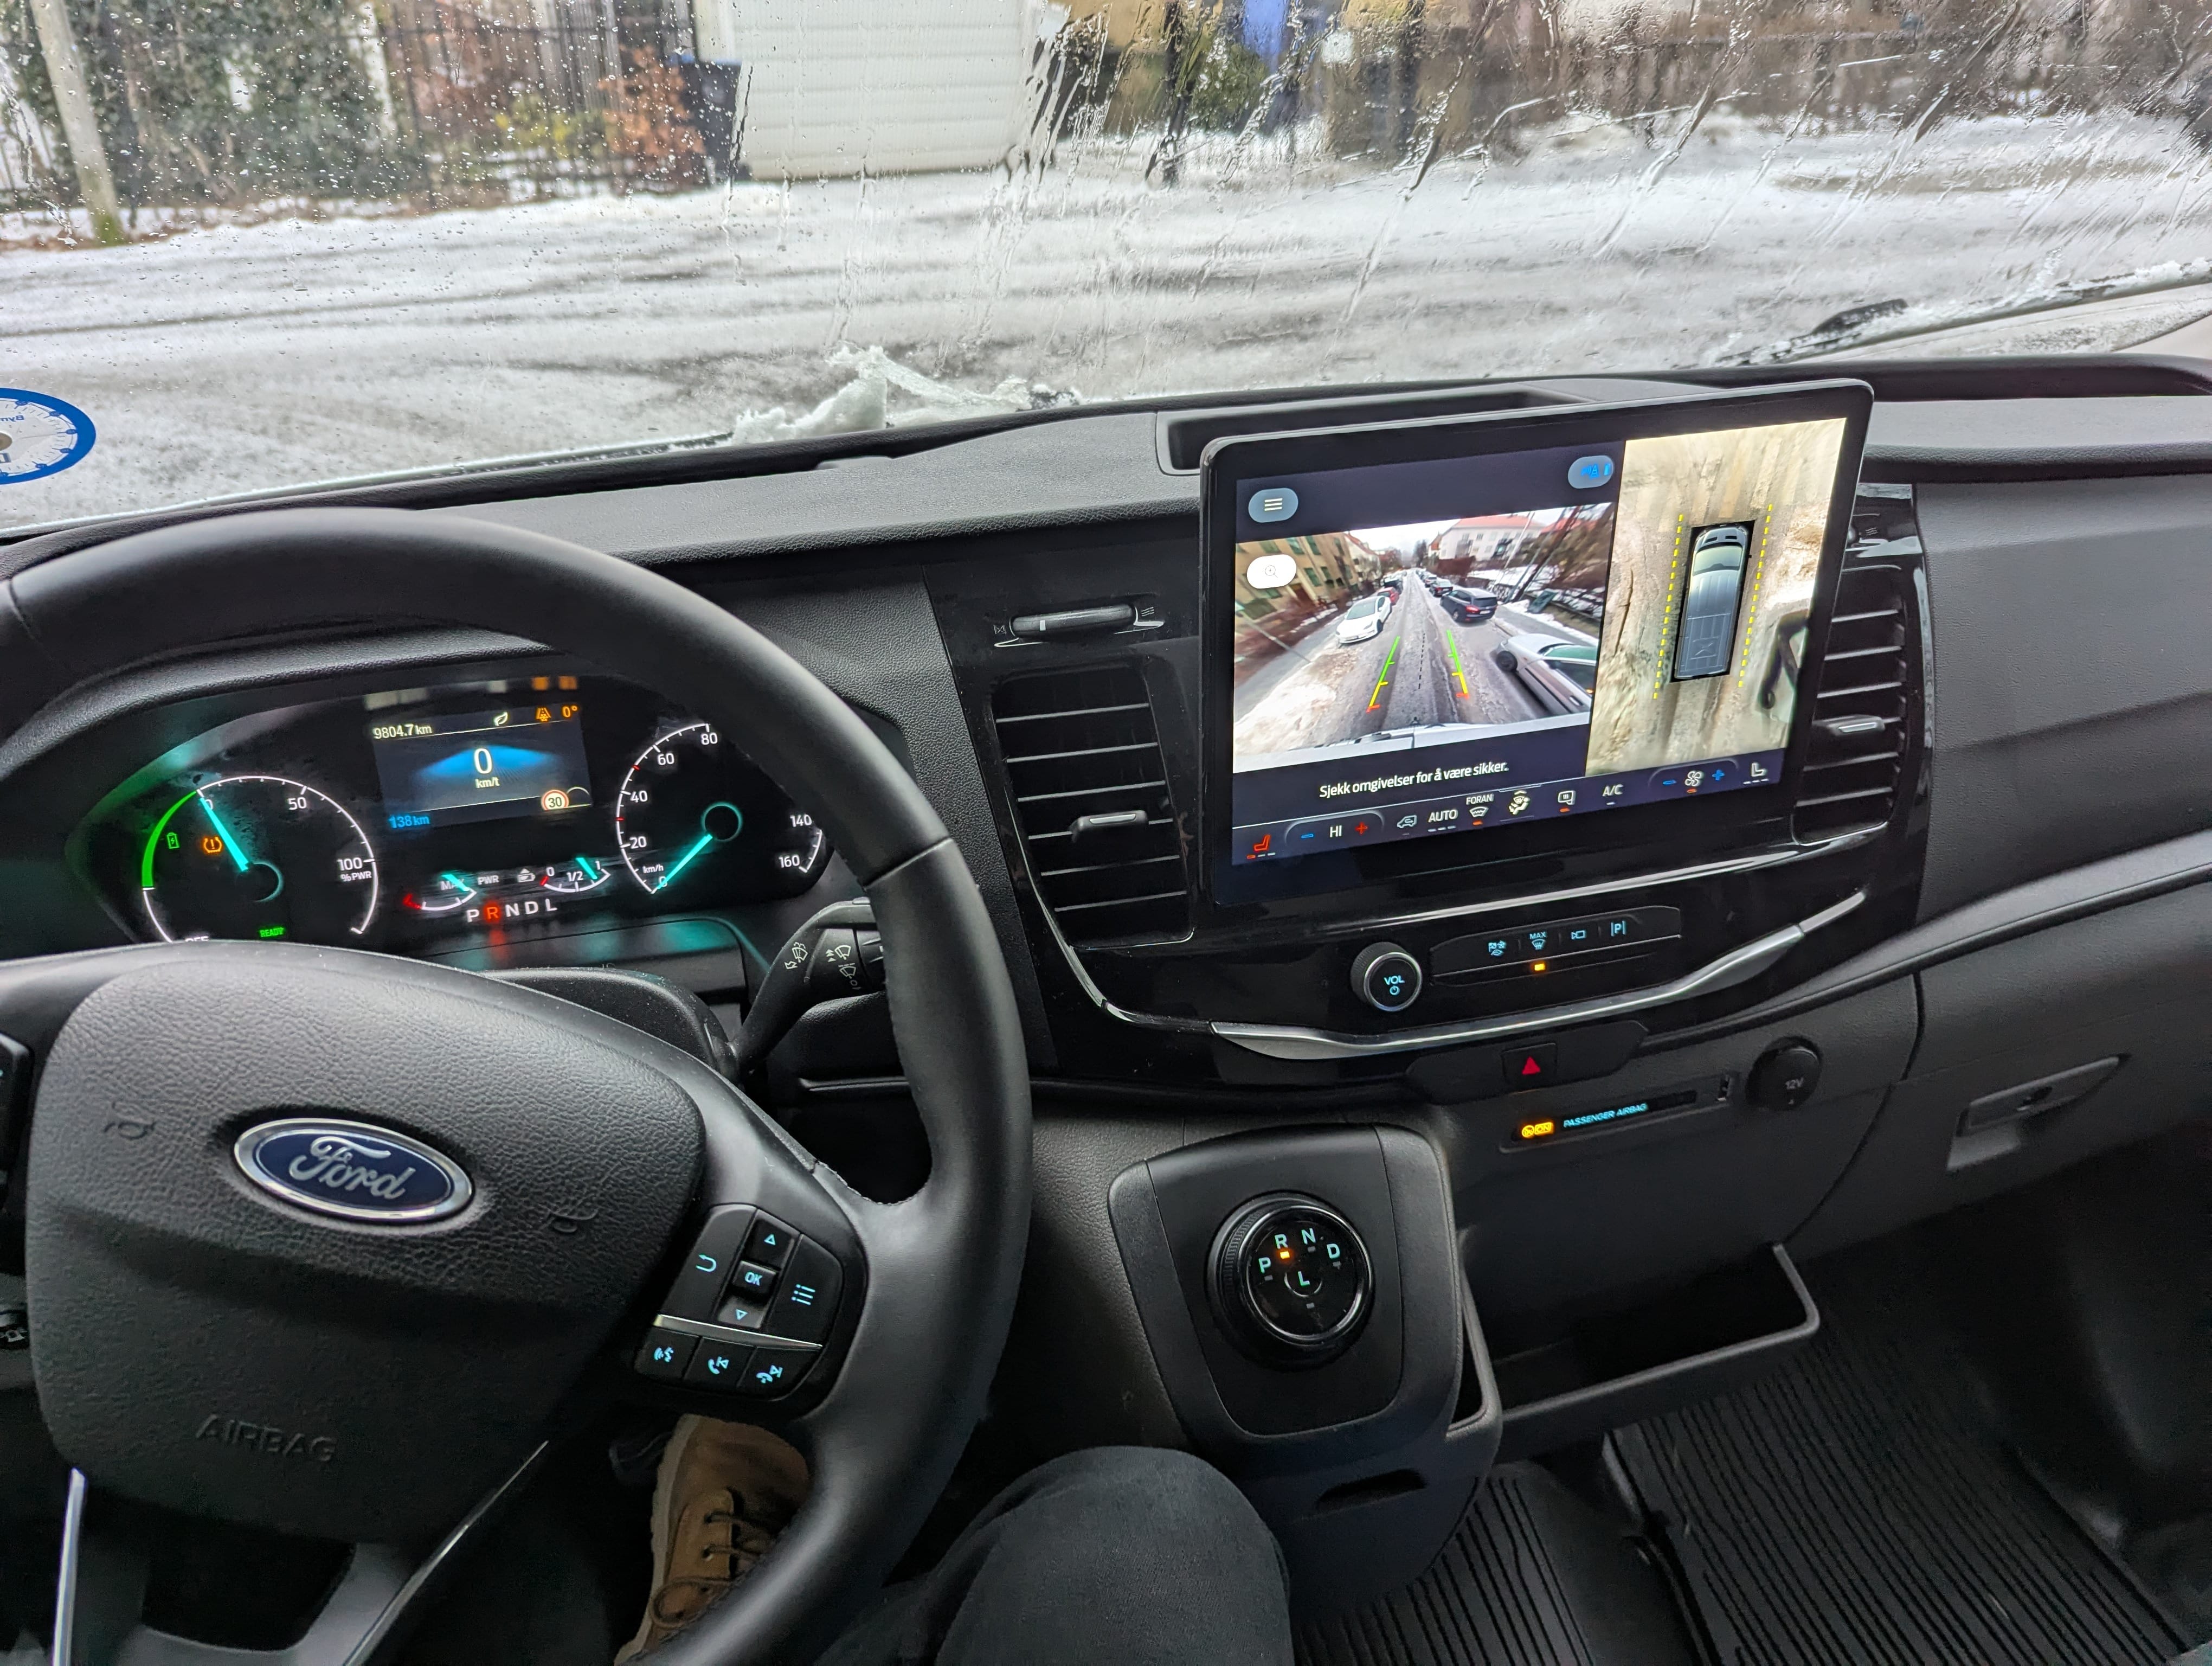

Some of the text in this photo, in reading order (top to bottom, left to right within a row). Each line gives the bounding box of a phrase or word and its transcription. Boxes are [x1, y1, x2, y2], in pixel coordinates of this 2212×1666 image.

[373, 723, 432, 740] 9804.7 km
[700, 732, 718, 746] 80
[473, 748, 493, 774] 0
[658, 753, 674, 766] 60
[475, 776, 500, 789] km/t
[1319, 762, 1510, 799] Sjekk omgivelser for å være sikker.
[630, 790, 648, 803] 40
[1603, 784, 1623, 798] A/C
[288, 797, 307, 810] 50
[548, 797, 562, 808] 30
[1466, 794, 1494, 805] FORAN
[389, 815, 430, 829] 138 km
[789, 813, 812, 828] 140
[1427, 809, 1458, 823] AUTO
[1329, 825, 1342, 838] HI
[630, 836, 647, 849] 20
[337, 857, 363, 871] 100
[595, 861, 601, 870] 1
[779, 855, 800, 868] 160
[546, 867, 555, 876] 0
[642, 863, 664, 874] km/h
[478, 875, 499, 885] PWR
[567, 871, 583, 882] 1/2
[466, 898, 558, 922] P R N D L
[260, 927, 285, 938] READY
[1529, 931, 1547, 939] MAX
[1384, 975, 1405, 985] VOL
[1564, 1103, 1648, 1128] PASSENGER AIRBAG
[289, 1136, 416, 1199] Ford
[1258, 1228, 1340, 1273] P R N D
[744, 1272, 763, 1286] OK
[1298, 1271, 1310, 1286] L
[196, 1413, 335, 1462] AIRBAG
